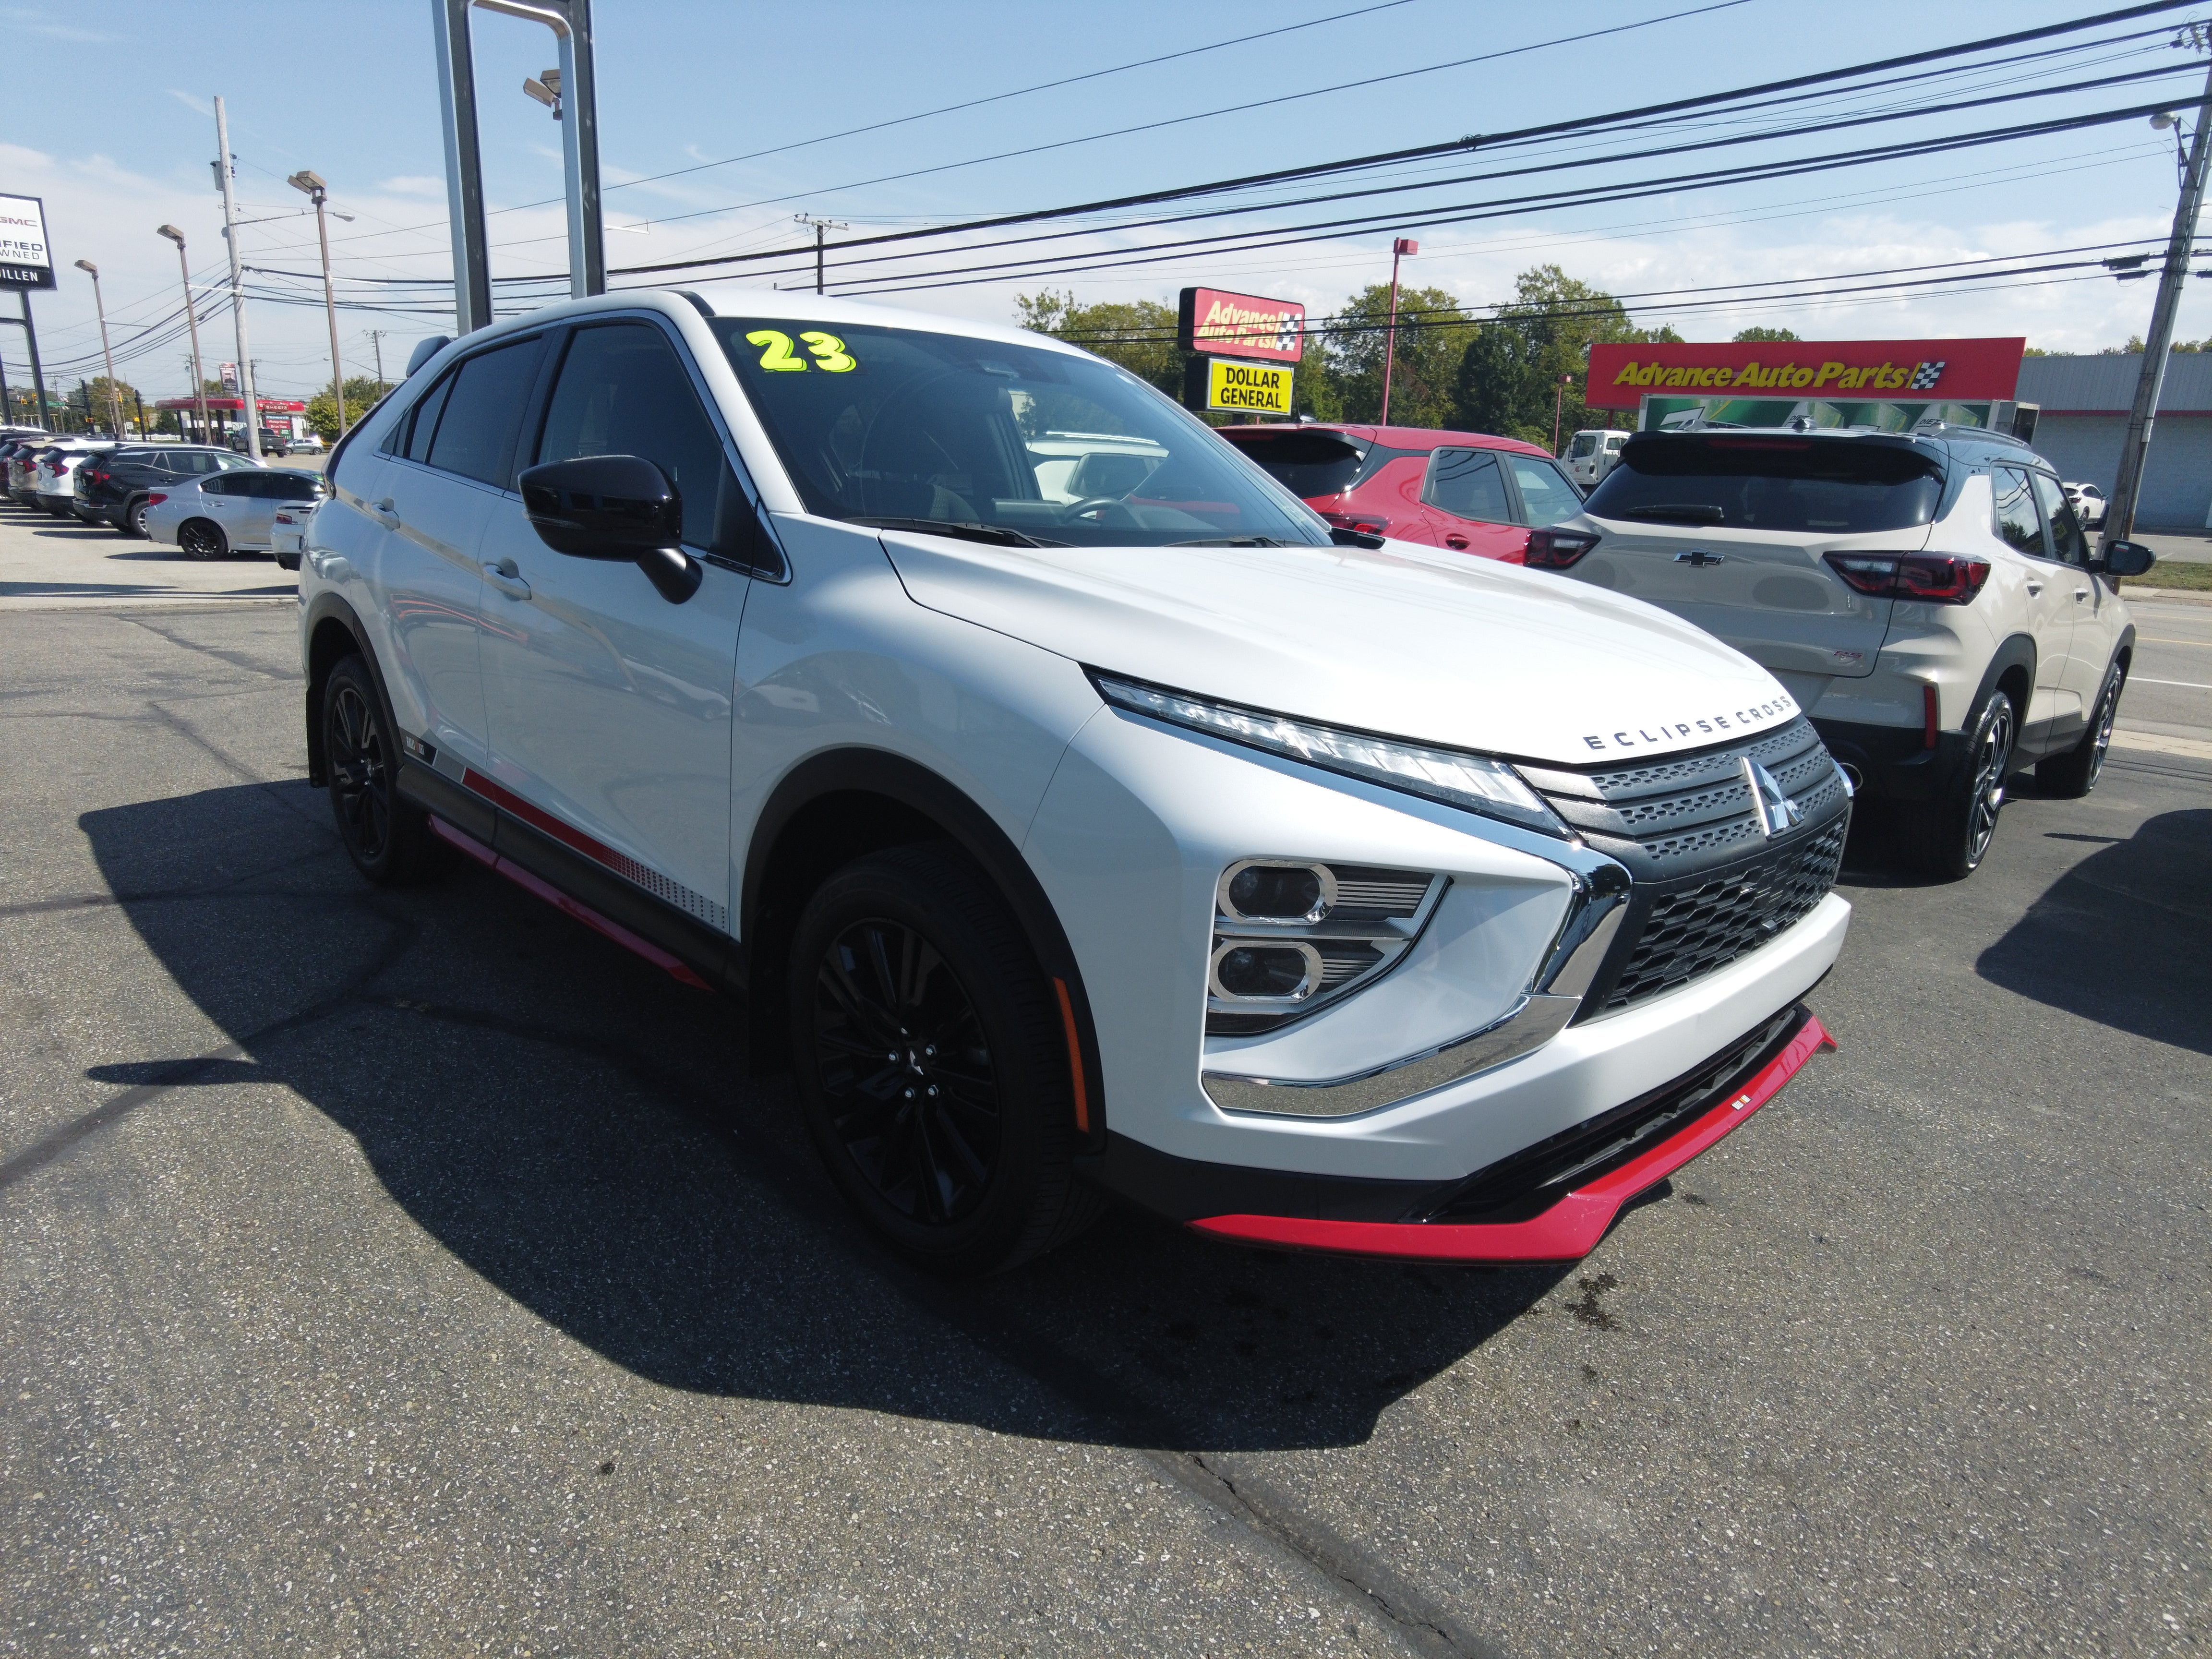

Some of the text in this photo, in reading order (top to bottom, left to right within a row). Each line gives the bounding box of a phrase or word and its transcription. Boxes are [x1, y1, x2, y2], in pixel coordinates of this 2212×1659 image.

[0, 269, 38, 282] ILLEN
[1204, 301, 1276, 331] Advance
[1197, 322, 1272, 349] Auto Parts
[745, 330, 857, 373] 23
[1226, 367, 1280, 389] DOLLAR
[1613, 362, 1910, 389] Advance Auto Parts
[1221, 387, 1282, 409] GENERAL
[1583, 696, 1791, 750] ECLIPSE CROSS
